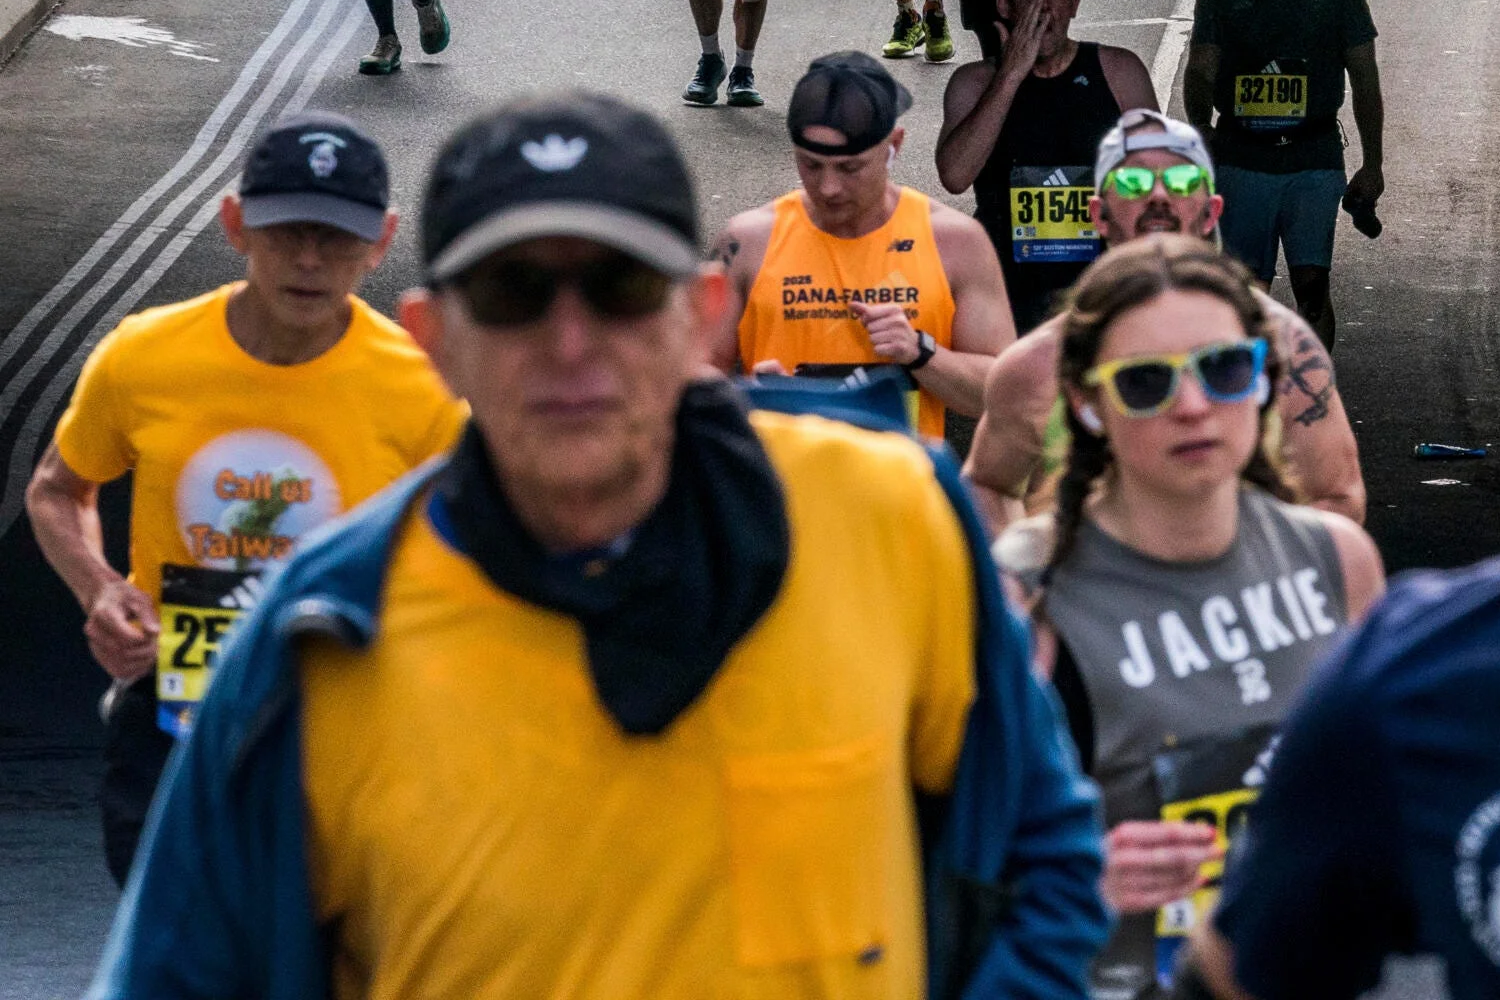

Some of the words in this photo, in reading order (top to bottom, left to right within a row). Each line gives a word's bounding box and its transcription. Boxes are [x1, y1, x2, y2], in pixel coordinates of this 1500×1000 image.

[1239, 77, 1303, 104] 32190
[1017, 190, 1095, 224] 31545
[782, 287, 919, 305] DANA-FARBER
[782, 308, 849, 321] Marathon
[214, 467, 273, 502] Call
[188, 521, 293, 562] Taiwa
[1117, 565, 1337, 690] JACKIE
